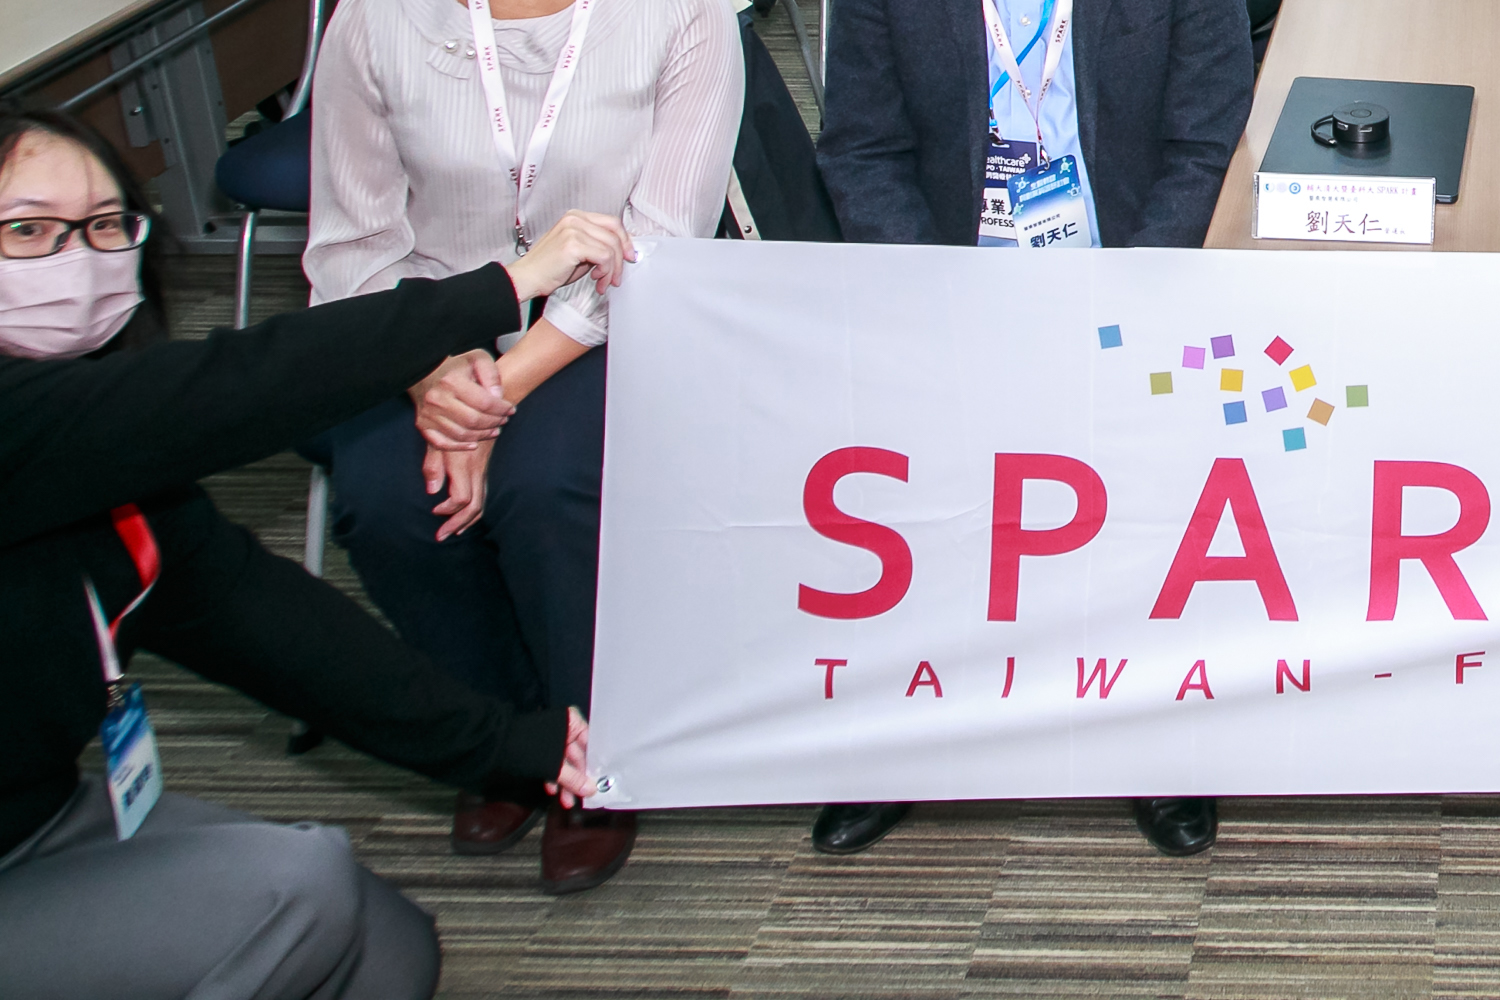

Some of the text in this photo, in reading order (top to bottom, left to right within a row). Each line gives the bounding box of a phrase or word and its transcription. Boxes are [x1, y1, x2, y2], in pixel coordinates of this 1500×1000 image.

[993, 23, 1004, 48] SPARK
[1055, 18, 1068, 43] SPARK
[483, 46, 494, 71] SPARK
[563, 44, 576, 69] SPARK
[494, 106, 506, 133] SPARK
[543, 104, 556, 129] SPARK
[526, 164, 537, 189] SPARK
[1376, 186, 1398, 195] SPARK
[1030, 222, 1079, 248] 劉天仁
[1305, 210, 1383, 235] 劉天仁
[813, 657, 1313, 701] TAIWAN
